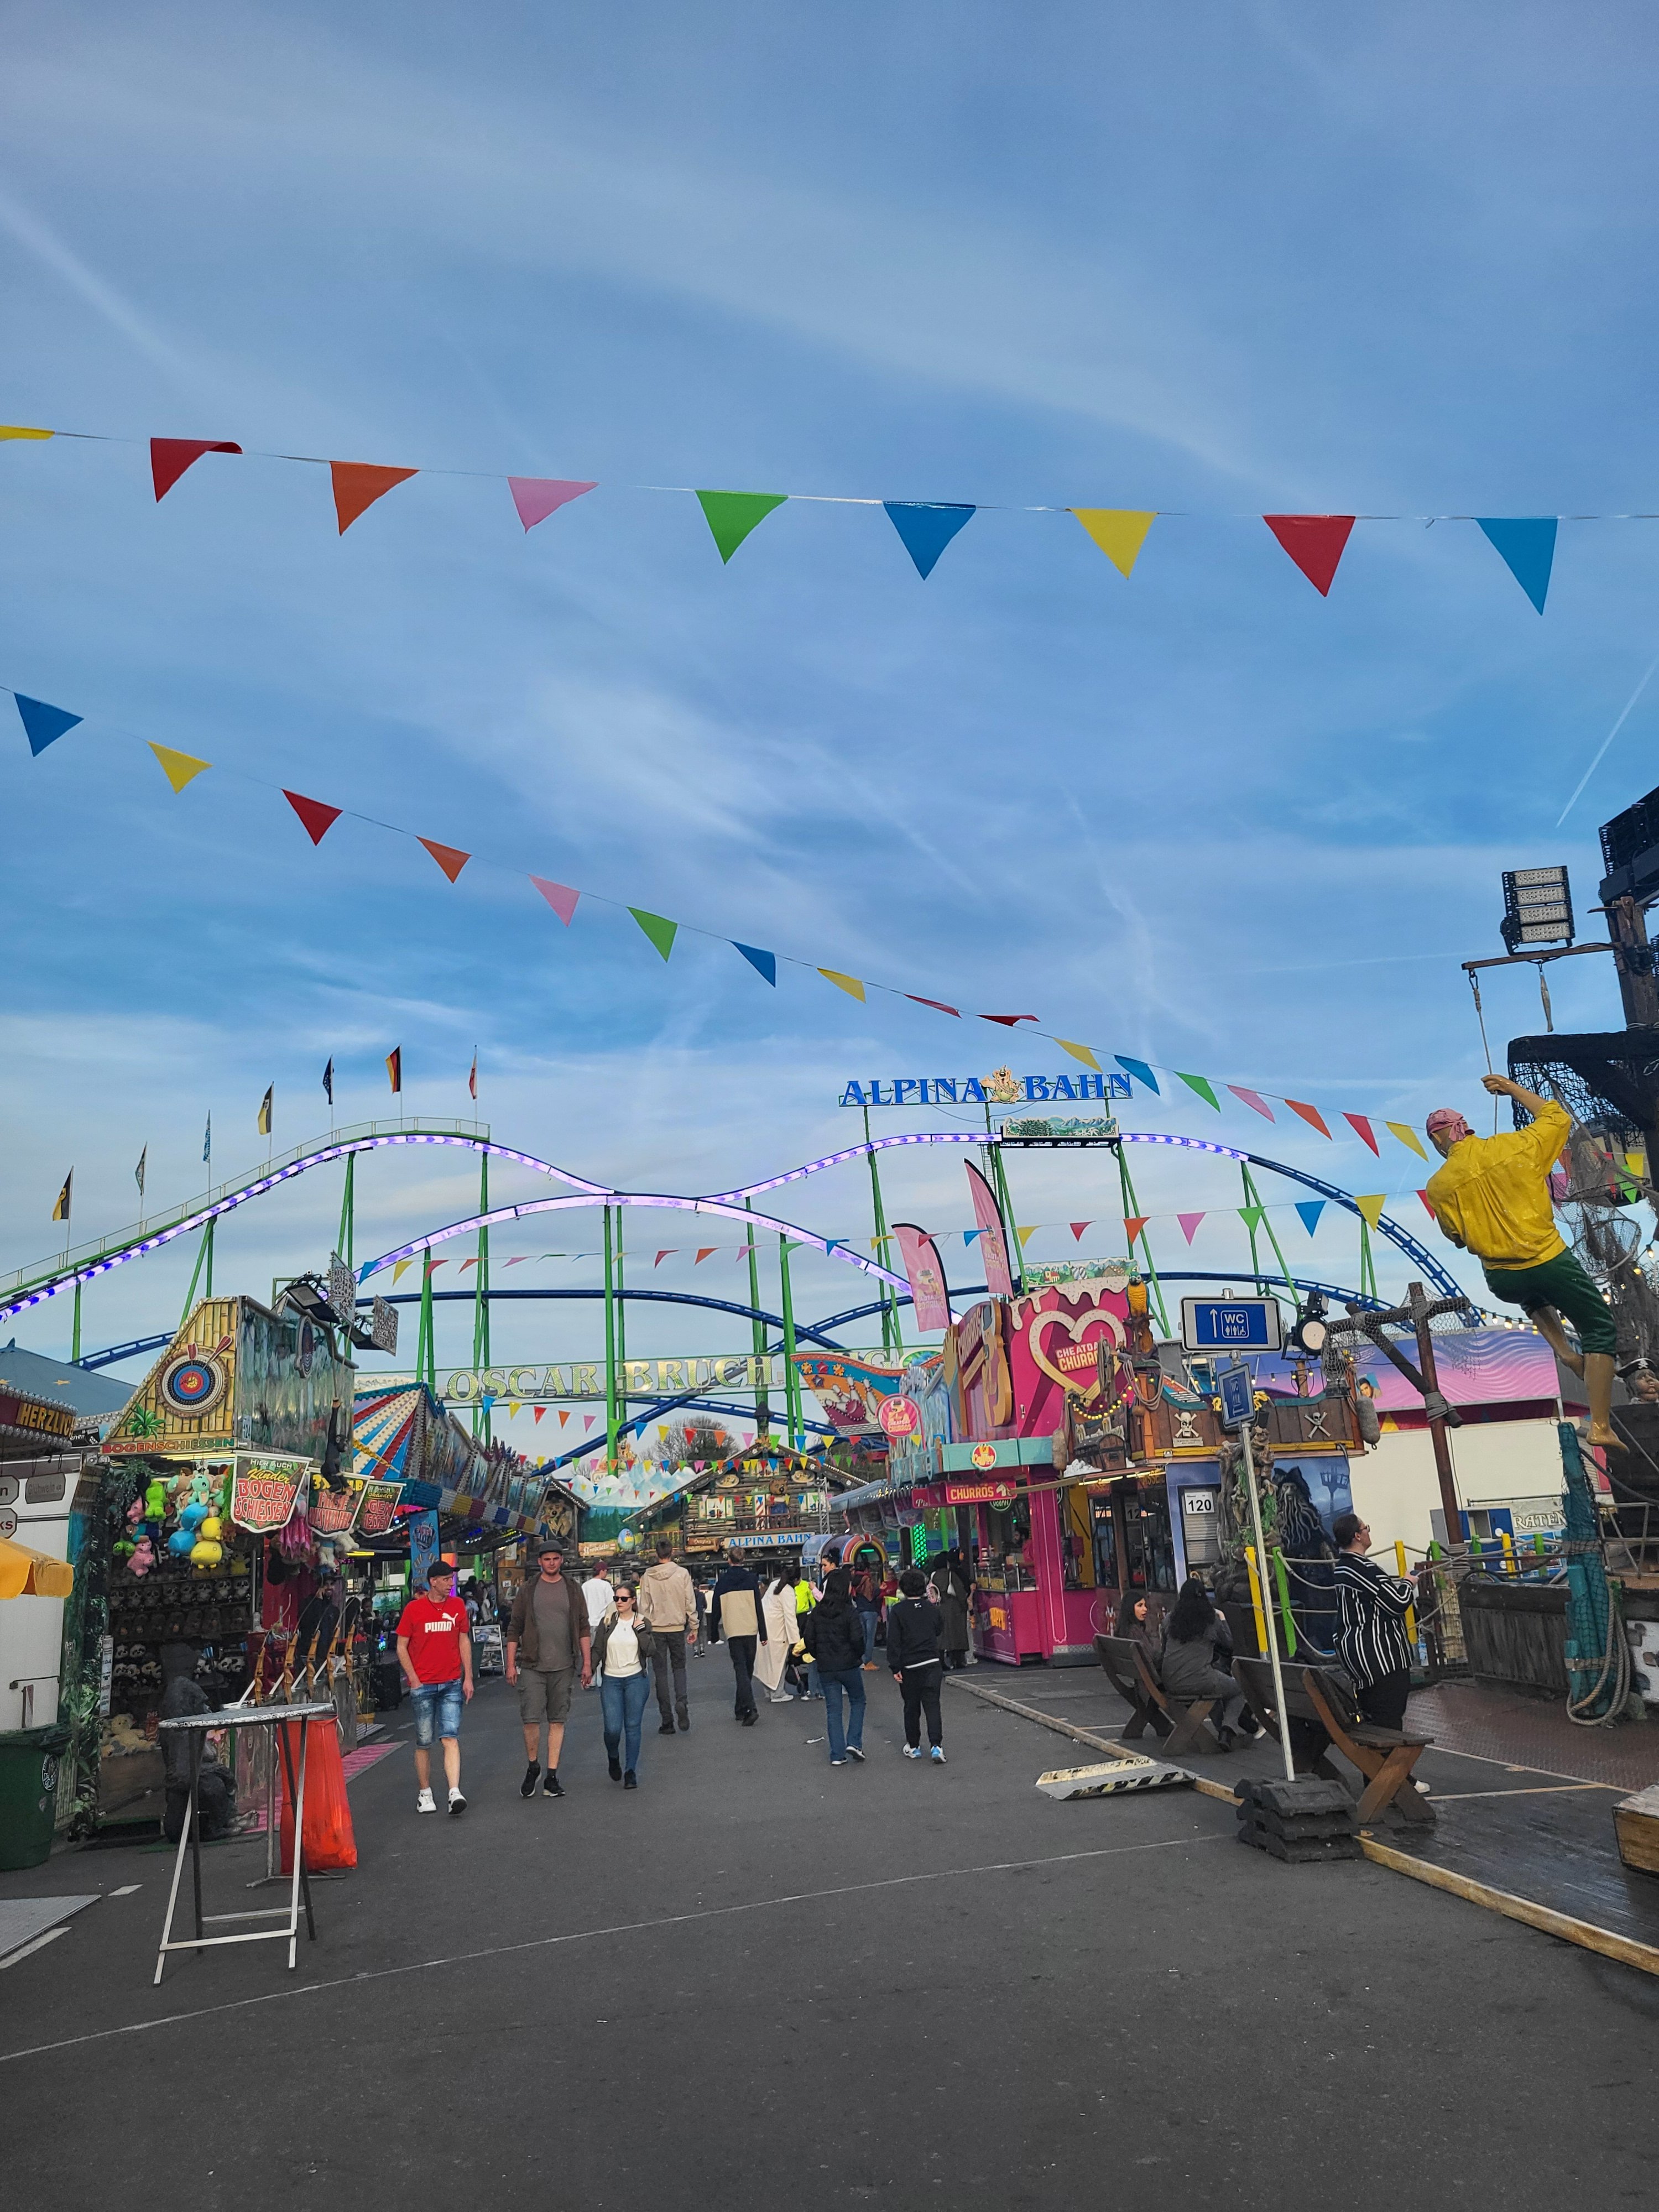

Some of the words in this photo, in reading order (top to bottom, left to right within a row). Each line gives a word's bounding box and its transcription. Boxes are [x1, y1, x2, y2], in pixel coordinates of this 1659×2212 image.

[841, 1077, 988, 1106] ALPINA
[1023, 1073, 1133, 1101] BAHN
[1224, 1314, 1244, 1324] WC
[1056, 1342, 1098, 1359] CHEATDA
[447, 1364, 602, 1401] OSCAR
[623, 1356, 776, 1392] BRUCH
[1231, 1380, 1239, 1392] WC
[102, 1438, 235, 1454] BOGENSCHIESSEN
[270, 1460, 292, 1469] AUCH
[247, 1468, 290, 1484] Kinder
[238, 1478, 296, 1502] BOGEN
[951, 1486, 994, 1500] CHURROS
[235, 1496, 291, 1522] SCHIESSEN
[1188, 1499, 1212, 1512] 120
[1513, 1510, 1568, 1530] RATEN
[729, 1536, 774, 1547] ALPINA
[777, 1533, 811, 1544] BAHN
[425, 1621, 452, 1633] PUMA
